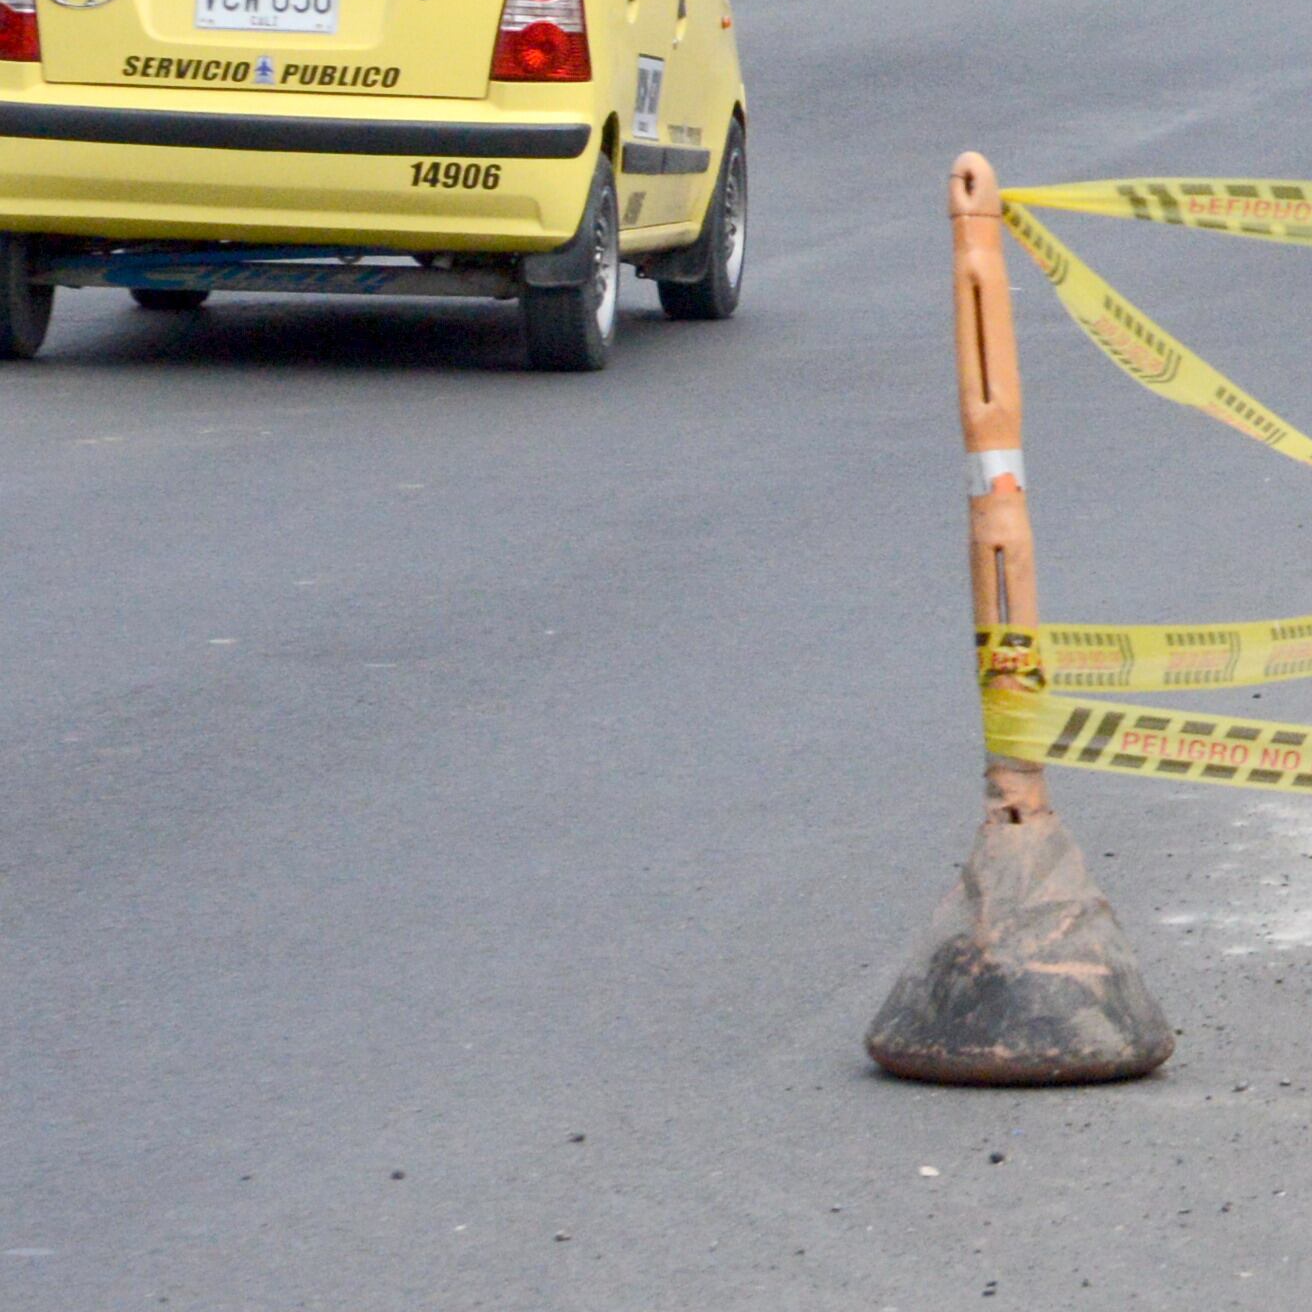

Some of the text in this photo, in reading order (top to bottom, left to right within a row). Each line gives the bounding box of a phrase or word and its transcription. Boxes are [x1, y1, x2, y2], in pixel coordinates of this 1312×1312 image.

[122, 55, 401, 88] SERVICIO PUBLICO
[410, 162, 502, 189] 14906
[1121, 731, 1249, 767] PELIGRO
[1261, 746, 1302, 771] NO
